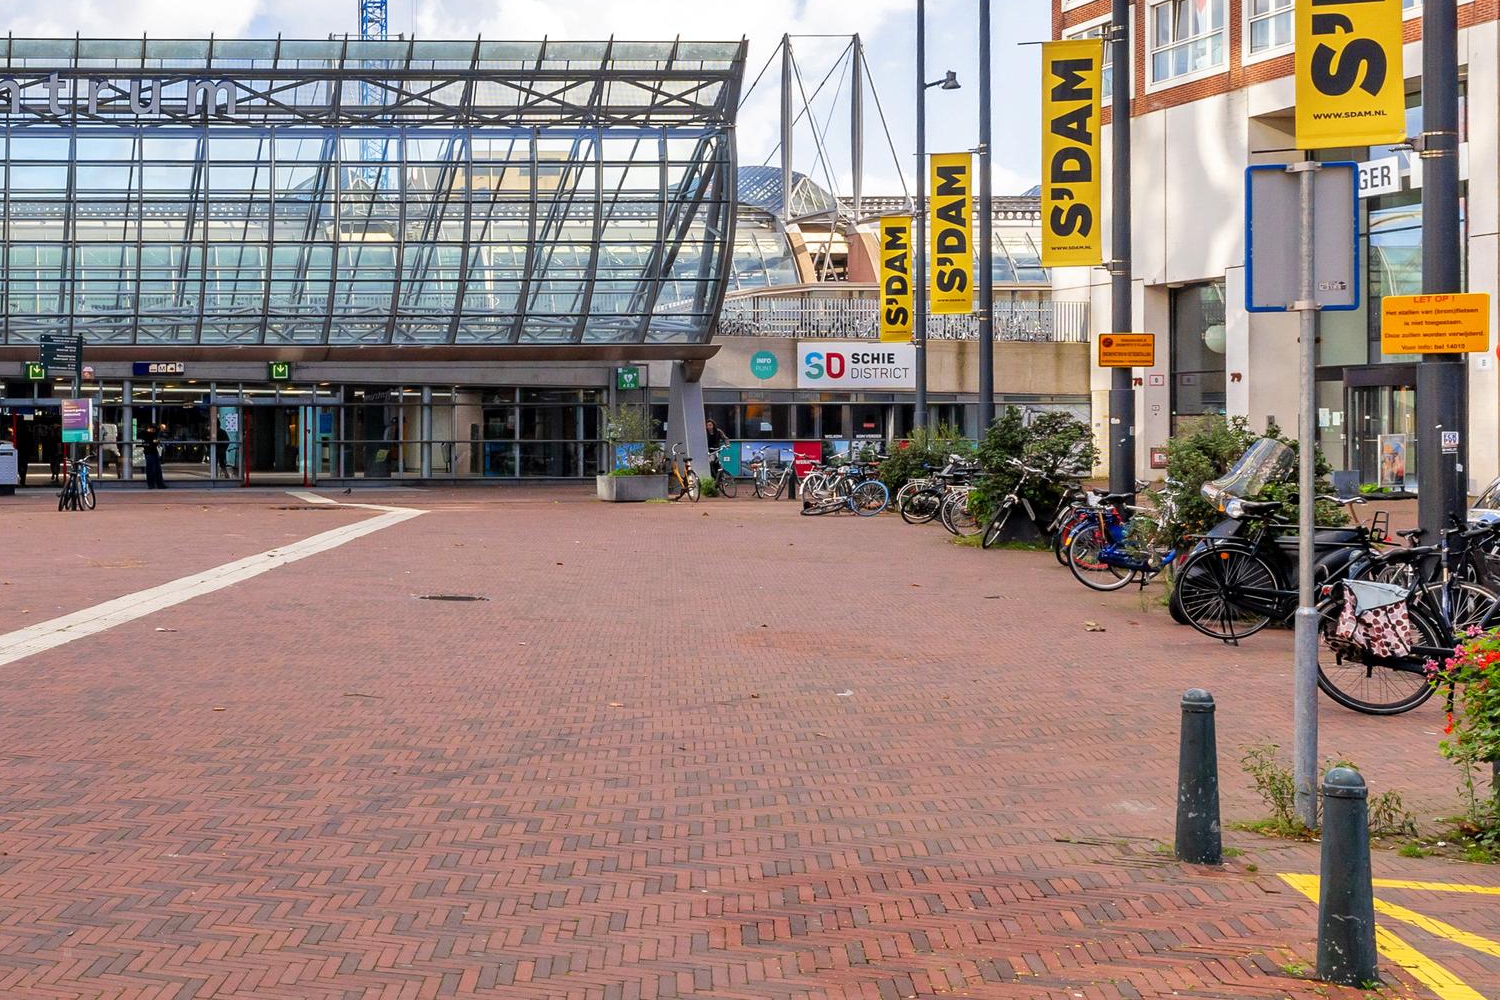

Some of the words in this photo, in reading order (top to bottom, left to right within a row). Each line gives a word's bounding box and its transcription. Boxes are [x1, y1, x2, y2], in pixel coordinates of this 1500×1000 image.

[1313, 110, 1387, 120] WWW.SDAM.NL
[1050, 58, 1093, 238] S'DAM
[936, 166, 967, 293] S'DAM
[885, 227, 908, 327] S'DAM
[1435, 295, 1449, 303] OP
[851, 353, 895, 364] SCHIE
[851, 367, 909, 379] DISTRICT
[1230, 372, 1241, 382] 79
